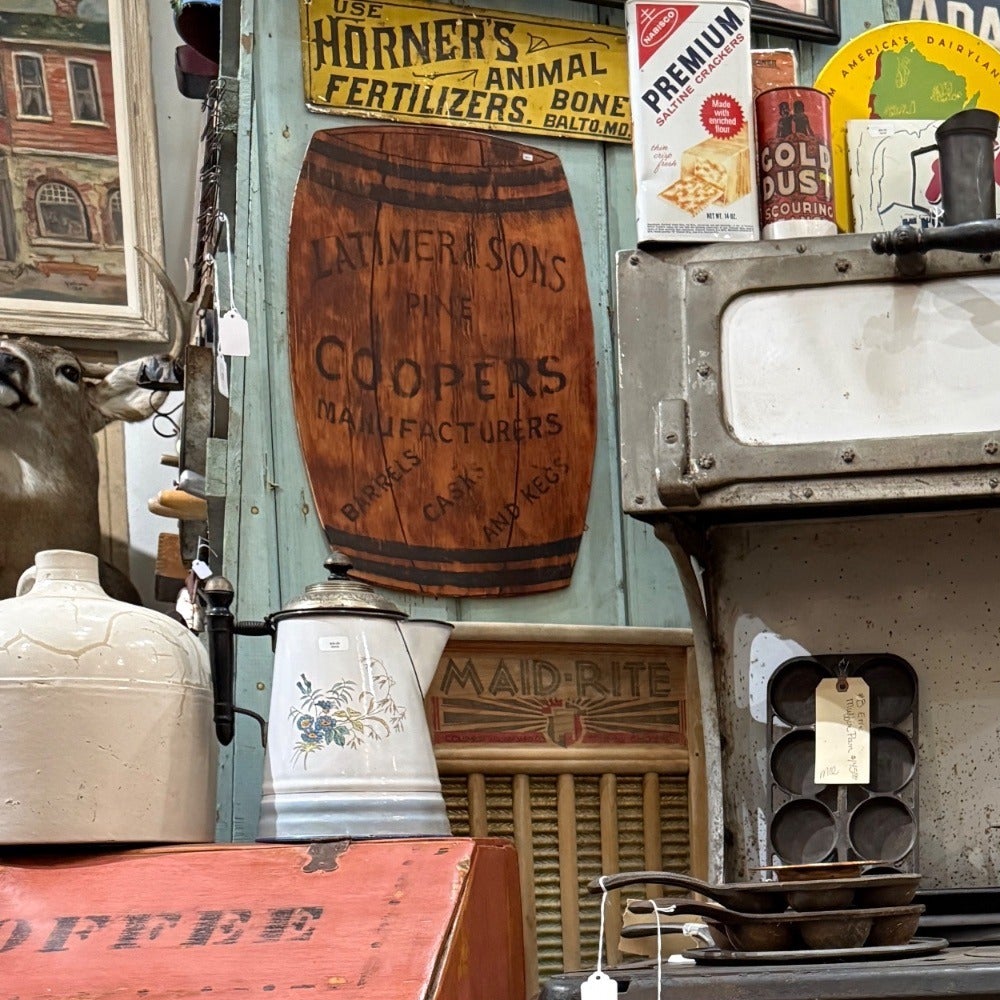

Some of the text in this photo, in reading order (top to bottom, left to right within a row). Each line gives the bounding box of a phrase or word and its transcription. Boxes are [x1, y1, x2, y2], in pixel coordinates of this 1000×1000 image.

[334, 0, 382, 19] USE
[644, 11, 675, 44] NABISCO
[313, 15, 520, 71] HORNER'S
[641, 6, 744, 114] PREMIUM
[841, 36, 909, 79] AMERICA'S
[484, 52, 608, 91] ANIMAL
[656, 33, 745, 127] SALTINE CRACKERS
[325, 73, 533, 125] FERTILIZERS.
[551, 88, 631, 118] BONE
[712, 99, 731, 109] Made
[714, 108, 730, 117] with
[709, 117, 737, 125] enriched
[715, 125, 731, 134] flour
[762, 142, 831, 172] GOLD
[763, 170, 832, 202] DUST
[765, 201, 834, 220] SCOURING
[311, 229, 458, 282] LATIMER
[486, 235, 566, 293] SONS
[406, 292, 473, 320] PINE
[316, 335, 567, 401] COOPERS
[317, 398, 563, 444] MANUFACTURERS
[340, 448, 421, 523] BARRELS
[422, 464, 485, 522] CASKS
[482, 456, 570, 543] AND KEGS
